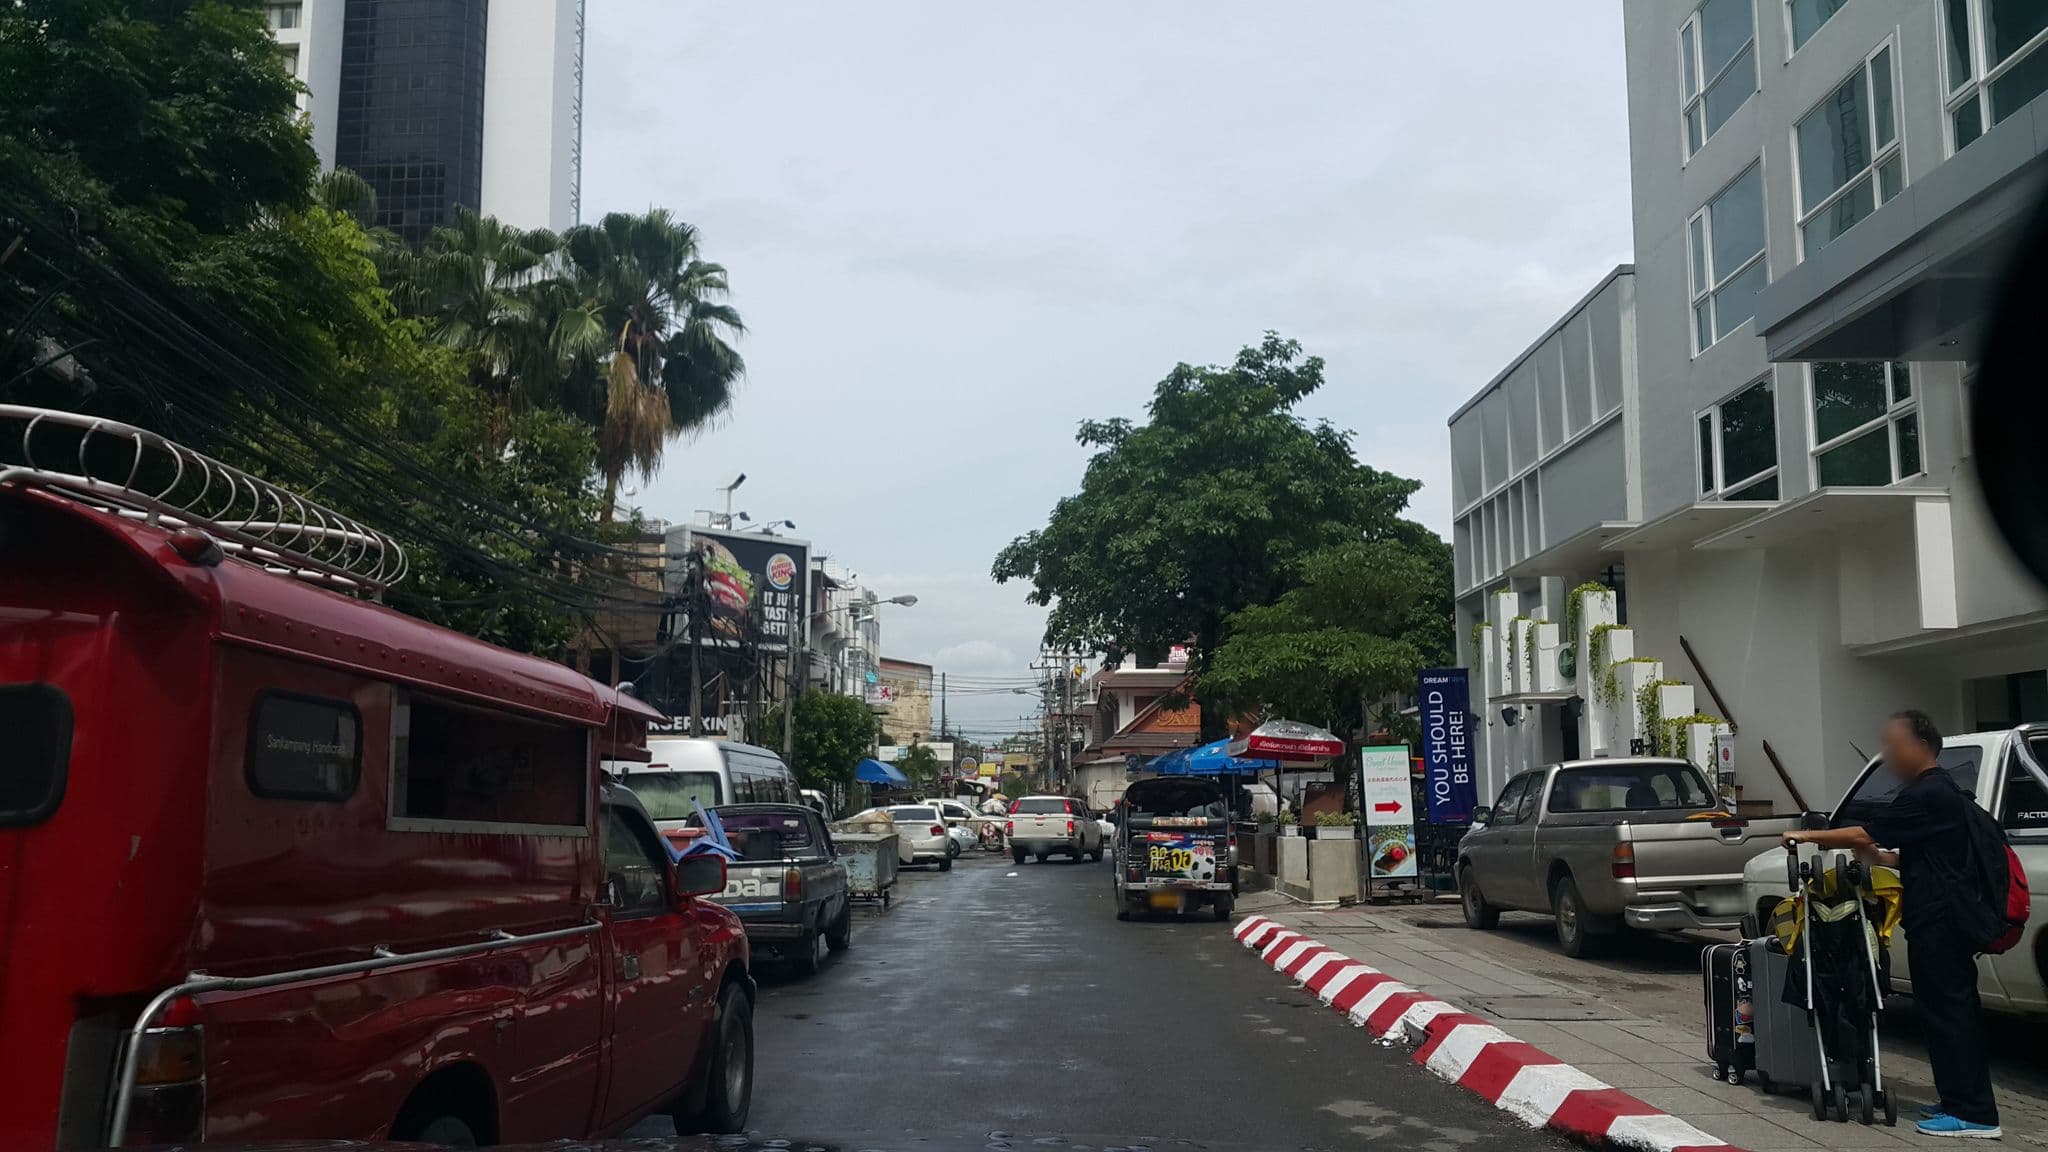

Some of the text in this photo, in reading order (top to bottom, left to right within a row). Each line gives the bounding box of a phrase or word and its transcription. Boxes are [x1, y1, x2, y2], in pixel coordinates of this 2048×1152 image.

[772, 568, 795, 579] KING
[764, 591, 800, 608] IT JUT
[764, 606, 799, 622] TASTS
[1428, 690, 1451, 806] YOU SHOULD
[1449, 710, 1469, 784] BE HERE!
